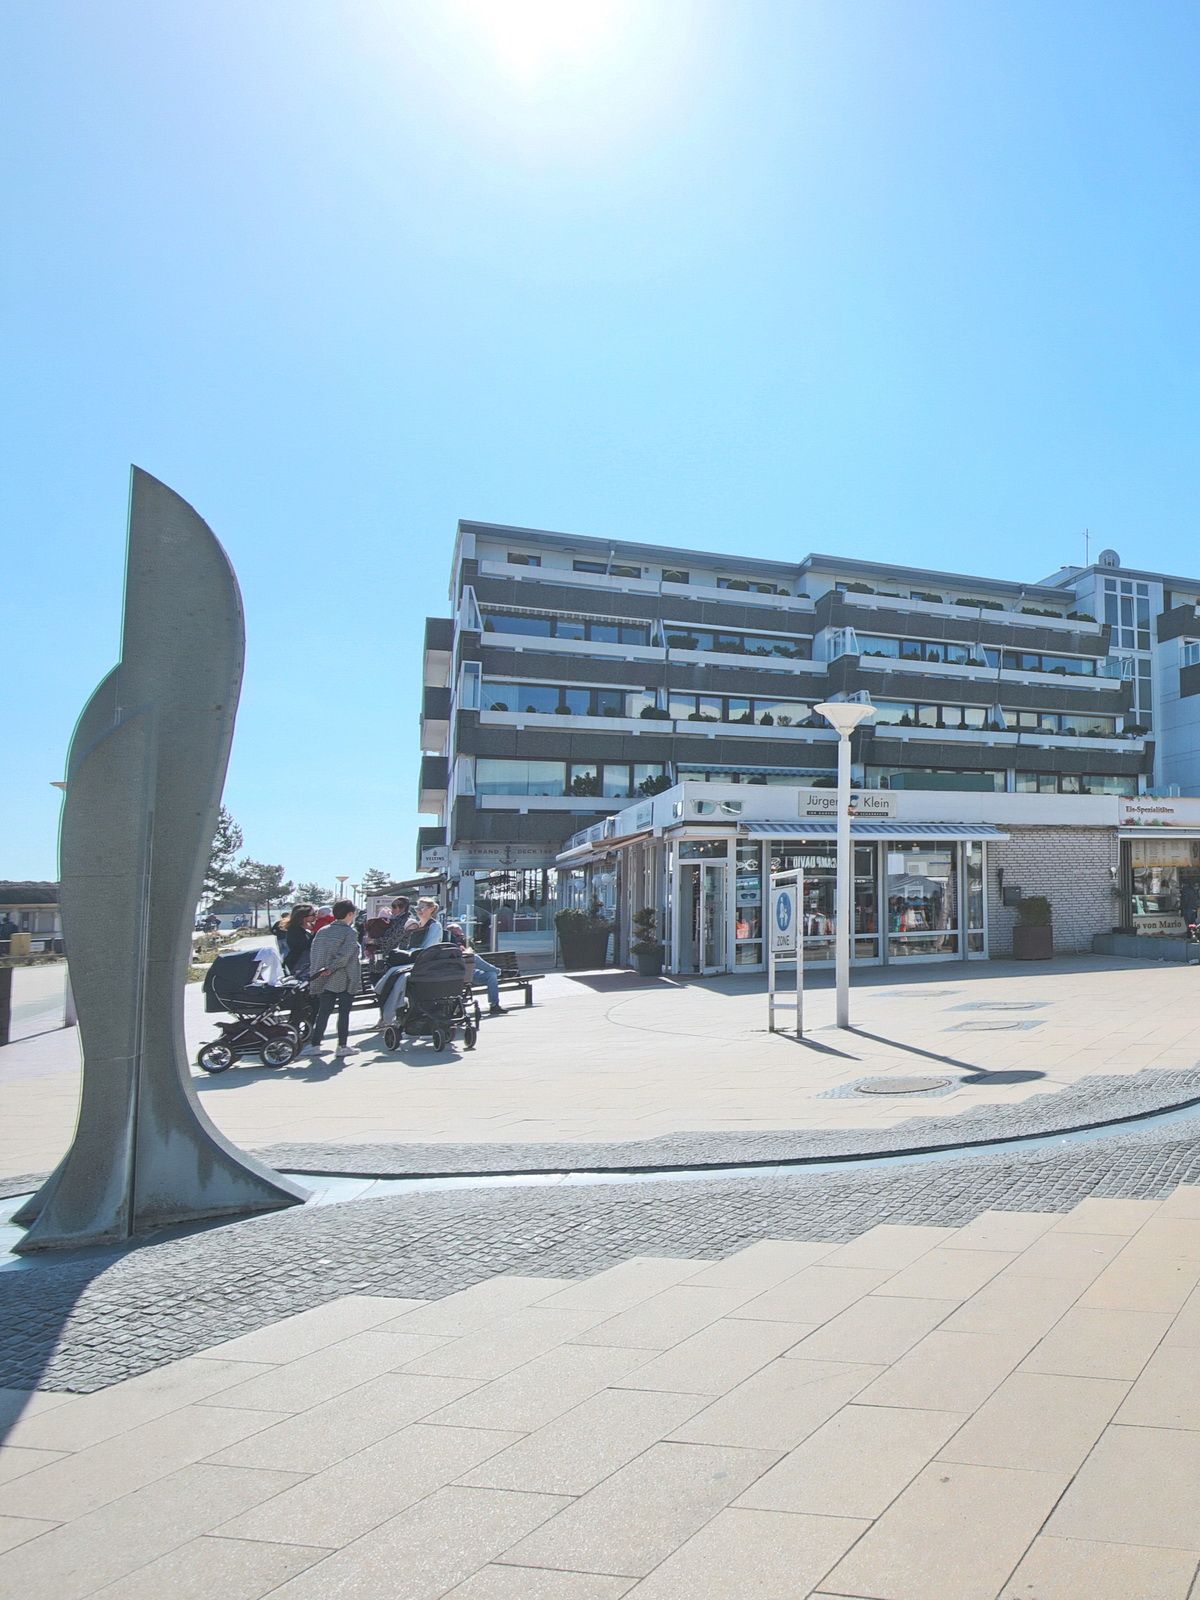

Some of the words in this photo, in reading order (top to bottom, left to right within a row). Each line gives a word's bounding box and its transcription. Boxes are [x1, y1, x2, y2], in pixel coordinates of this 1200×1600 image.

[864, 797, 889, 808] Klein
[1125, 806, 1175, 814] Eis-Spezialitäten
[1159, 920, 1182, 929] Mario
[777, 935, 790, 947] ZONE
